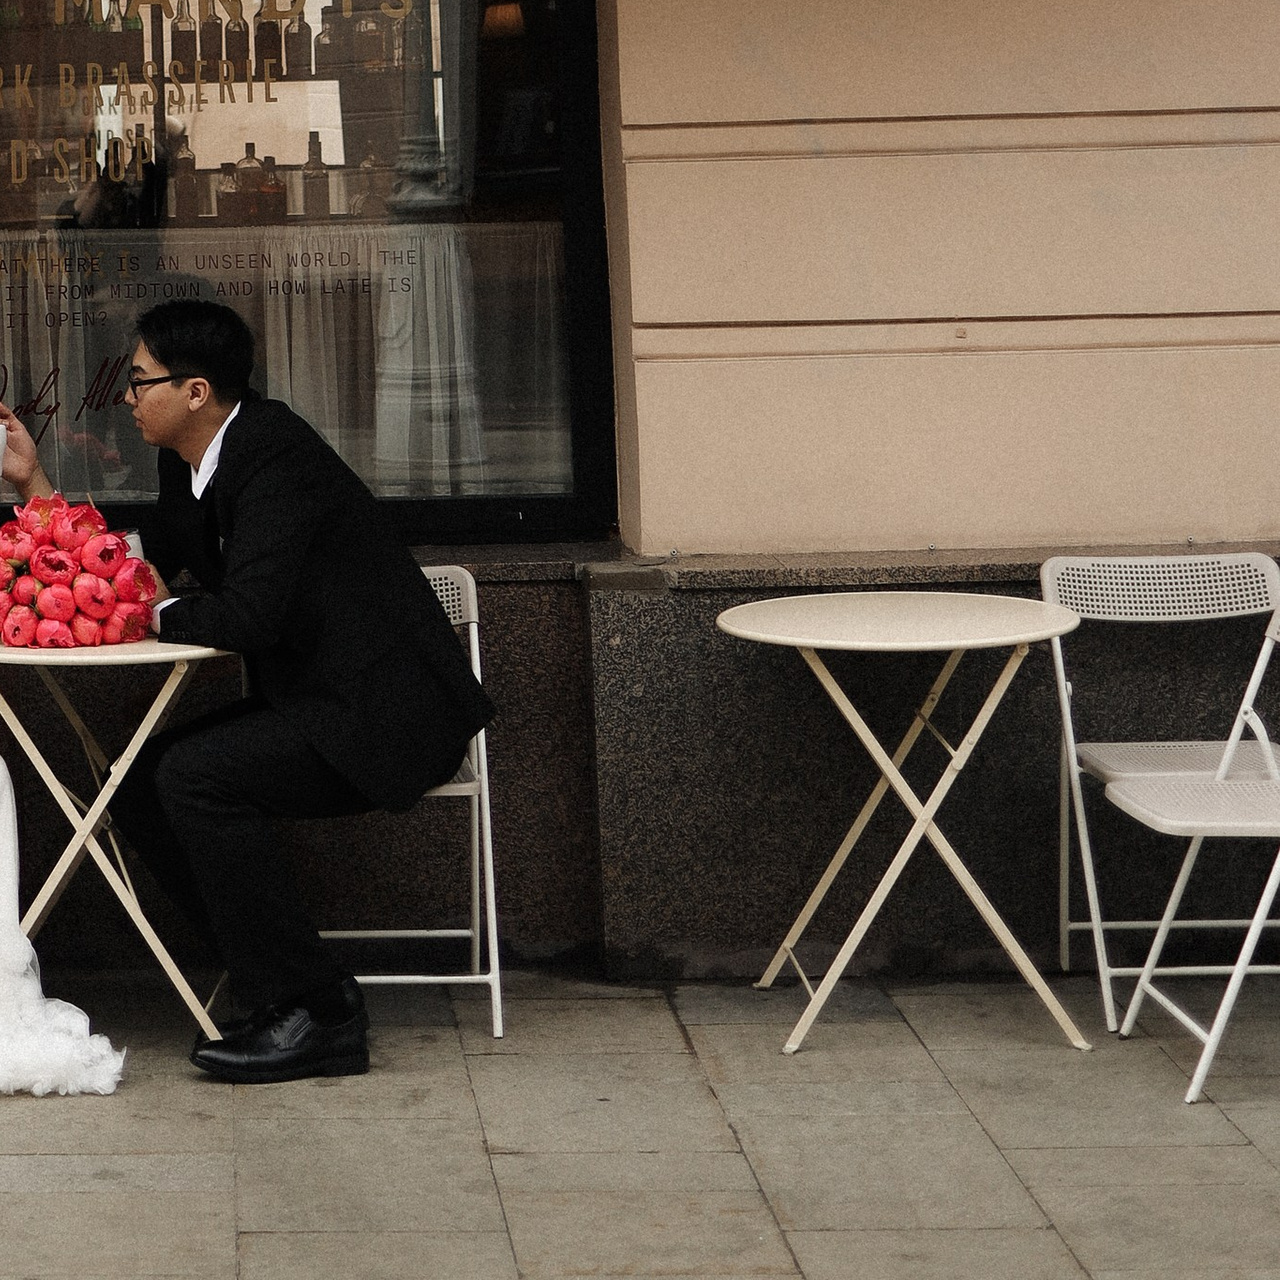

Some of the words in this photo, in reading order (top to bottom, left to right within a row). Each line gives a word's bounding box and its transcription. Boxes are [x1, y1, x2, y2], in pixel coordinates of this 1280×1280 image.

[58, 58, 279, 108] BRASSERIE
[53, 136, 153, 185] SHOP
[36, 256, 101, 273] THERE
[116, 255, 140, 272] IS
[155, 255, 180, 271] AN
[194, 253, 272, 270] UNSEEN
[287, 251, 362, 268] WORLD.
[378, 249, 417, 266] THE
[5, 285, 29, 302] IT
[44, 285, 95, 301] FROM
[109, 282, 201, 299] MIDTOWN
[215, 281, 253, 297] AND
[268, 279, 307, 296] HOW
[321, 278, 371, 295] LATE
[387, 276, 412, 293] IS
[6, 313, 30, 329] IT
[44, 311, 108, 328] OPEN?
